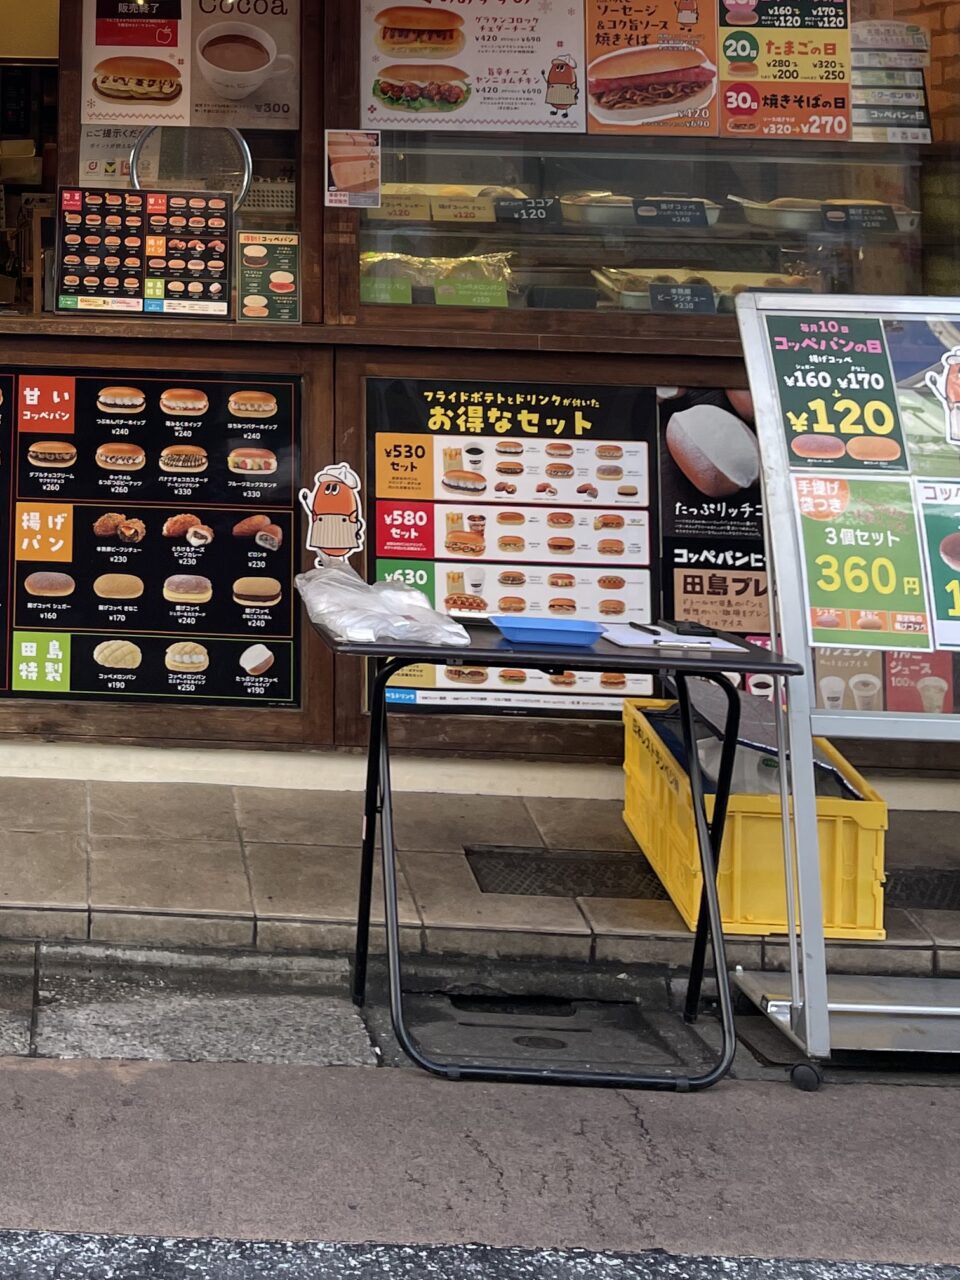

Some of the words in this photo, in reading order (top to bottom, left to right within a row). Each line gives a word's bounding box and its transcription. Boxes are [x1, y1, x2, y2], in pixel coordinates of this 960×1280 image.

[118, 3, 160, 14] 販売終了
[597, 4, 658, 17] ソーセージ
[768, 6, 792, 16] ¥160
[812, 7, 836, 17] ¥170
[774, 16, 801, 27] ¥120
[818, 16, 845, 28] ¥120
[480, 25, 536, 33] チェダーチーズ
[474, 34, 498, 42] ¥420
[595, 32, 650, 46] 焼きそば
[765, 39, 837, 57] たまごの日
[766, 59, 791, 68] ¥280
[812, 60, 837, 69] ¥320
[772, 69, 800, 80] ¥200
[819, 70, 845, 81] ¥250
[475, 86, 499, 94] ¥420
[762, 94, 846, 109] 焼きそばの日
[254, 103, 291, 114] ¥300
[762, 123, 792, 134] ¥320
[800, 115, 848, 134] ¥270
[527, 199, 554, 208] ココア
[513, 209, 547, 219] ¥120
[800, 320, 849, 333] 毎月10日
[773, 336, 883, 354] コッペパンの日
[809, 355, 853, 364] 揚げコッペ
[783, 371, 832, 388] ¥160
[837, 373, 885, 390] ¥170
[23, 387, 70, 405] 甘い
[423, 390, 600, 409] フライドポテトとドリンクが付いた
[22, 410, 70, 421] コッペパン
[427, 406, 593, 435] お得なセット
[786, 398, 895, 435] ¥120
[174, 430, 193, 438] ¥240
[243, 432, 261, 440] ¥240
[384, 444, 426, 459] ¥530
[390, 461, 418, 472] セット
[798, 480, 840, 496] 手提げ
[242, 490, 261, 498] ¥330
[21, 511, 68, 531] 揚げ
[383, 510, 428, 526] ¥580
[390, 527, 419, 540] セット
[824, 527, 901, 548] 3個セット
[21, 534, 65, 552] パン
[109, 555, 128, 563] ¥230
[247, 560, 266, 568] ¥230
[384, 569, 428, 585] ¥630
[815, 554, 920, 595] 360円
[39, 612, 57, 620] ¥160
[108, 614, 126, 622] ¥170
[177, 617, 196, 625] ¥240
[20, 639, 63, 660] 田島
[18, 661, 63, 682] 特製
[890, 661, 932, 674] ジュース
[107, 681, 125, 689] ¥190
[177, 684, 196, 692] ¥250
